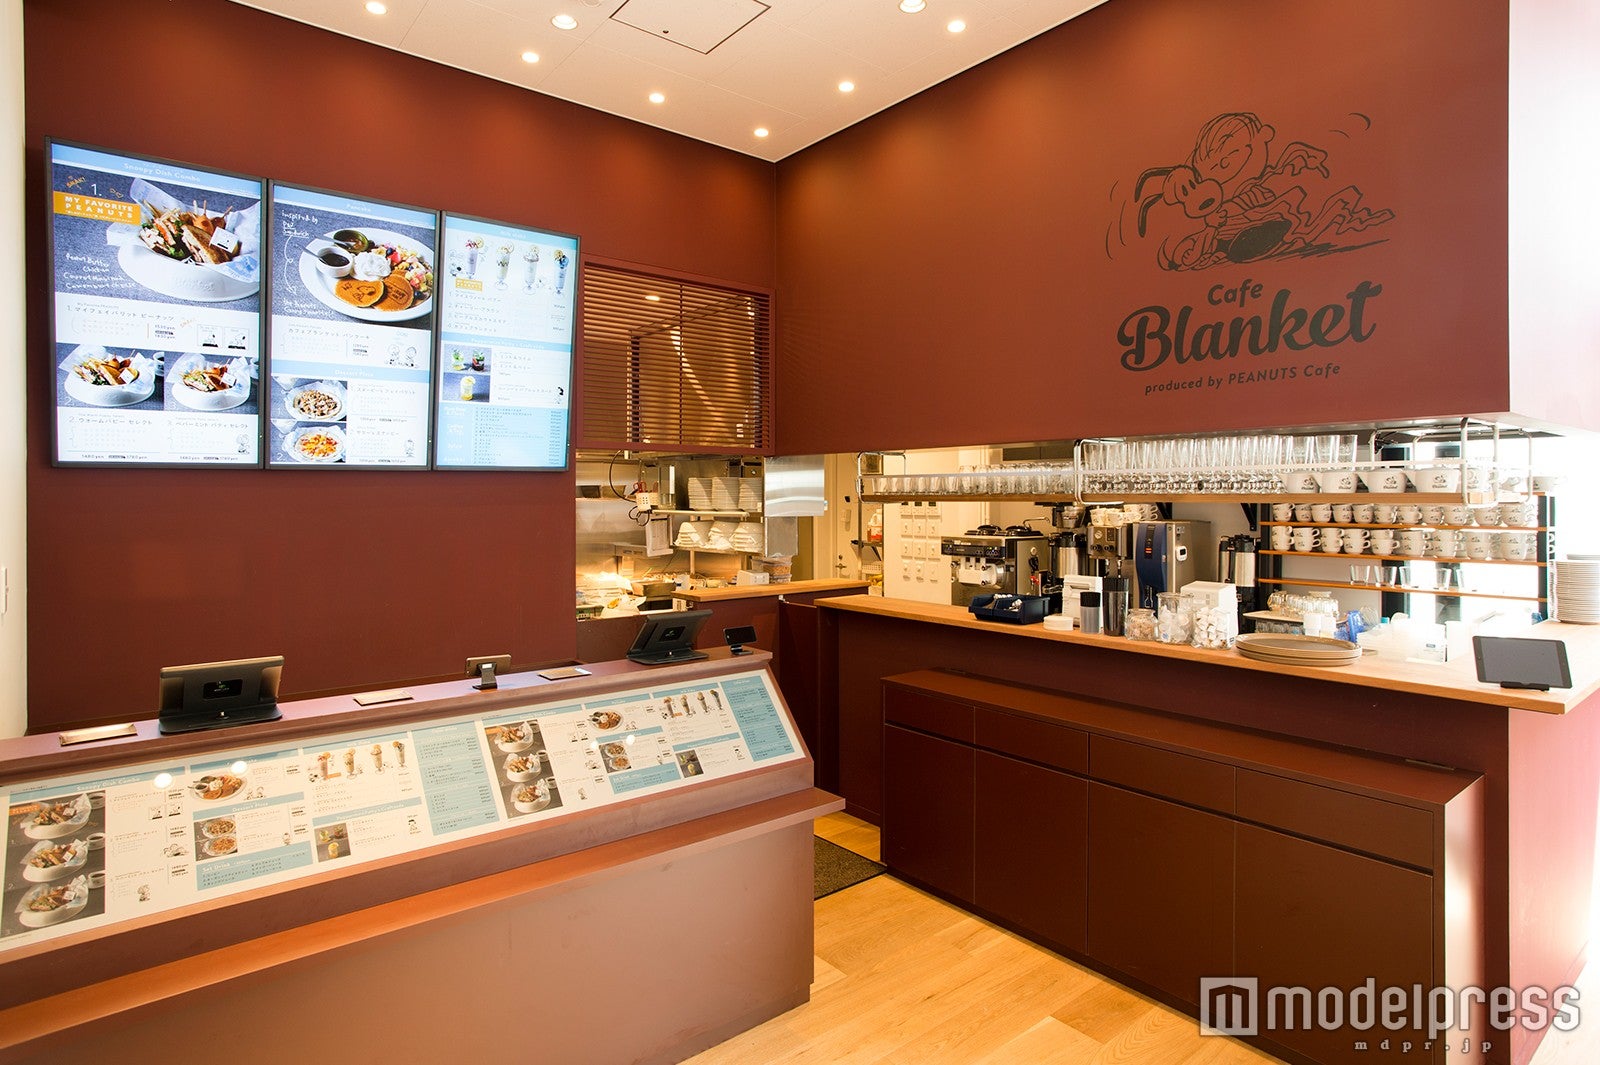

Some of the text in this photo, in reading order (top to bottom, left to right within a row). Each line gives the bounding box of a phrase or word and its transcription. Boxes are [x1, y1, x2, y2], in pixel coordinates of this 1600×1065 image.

[65, 203, 133, 218] PEANUTS
[85, 200, 133, 212] FAVORITE
[1207, 278, 1264, 308] Cafe
[1116, 280, 1383, 372] Blanket
[1145, 363, 1341, 396] produced by PEANUTS Cafe
